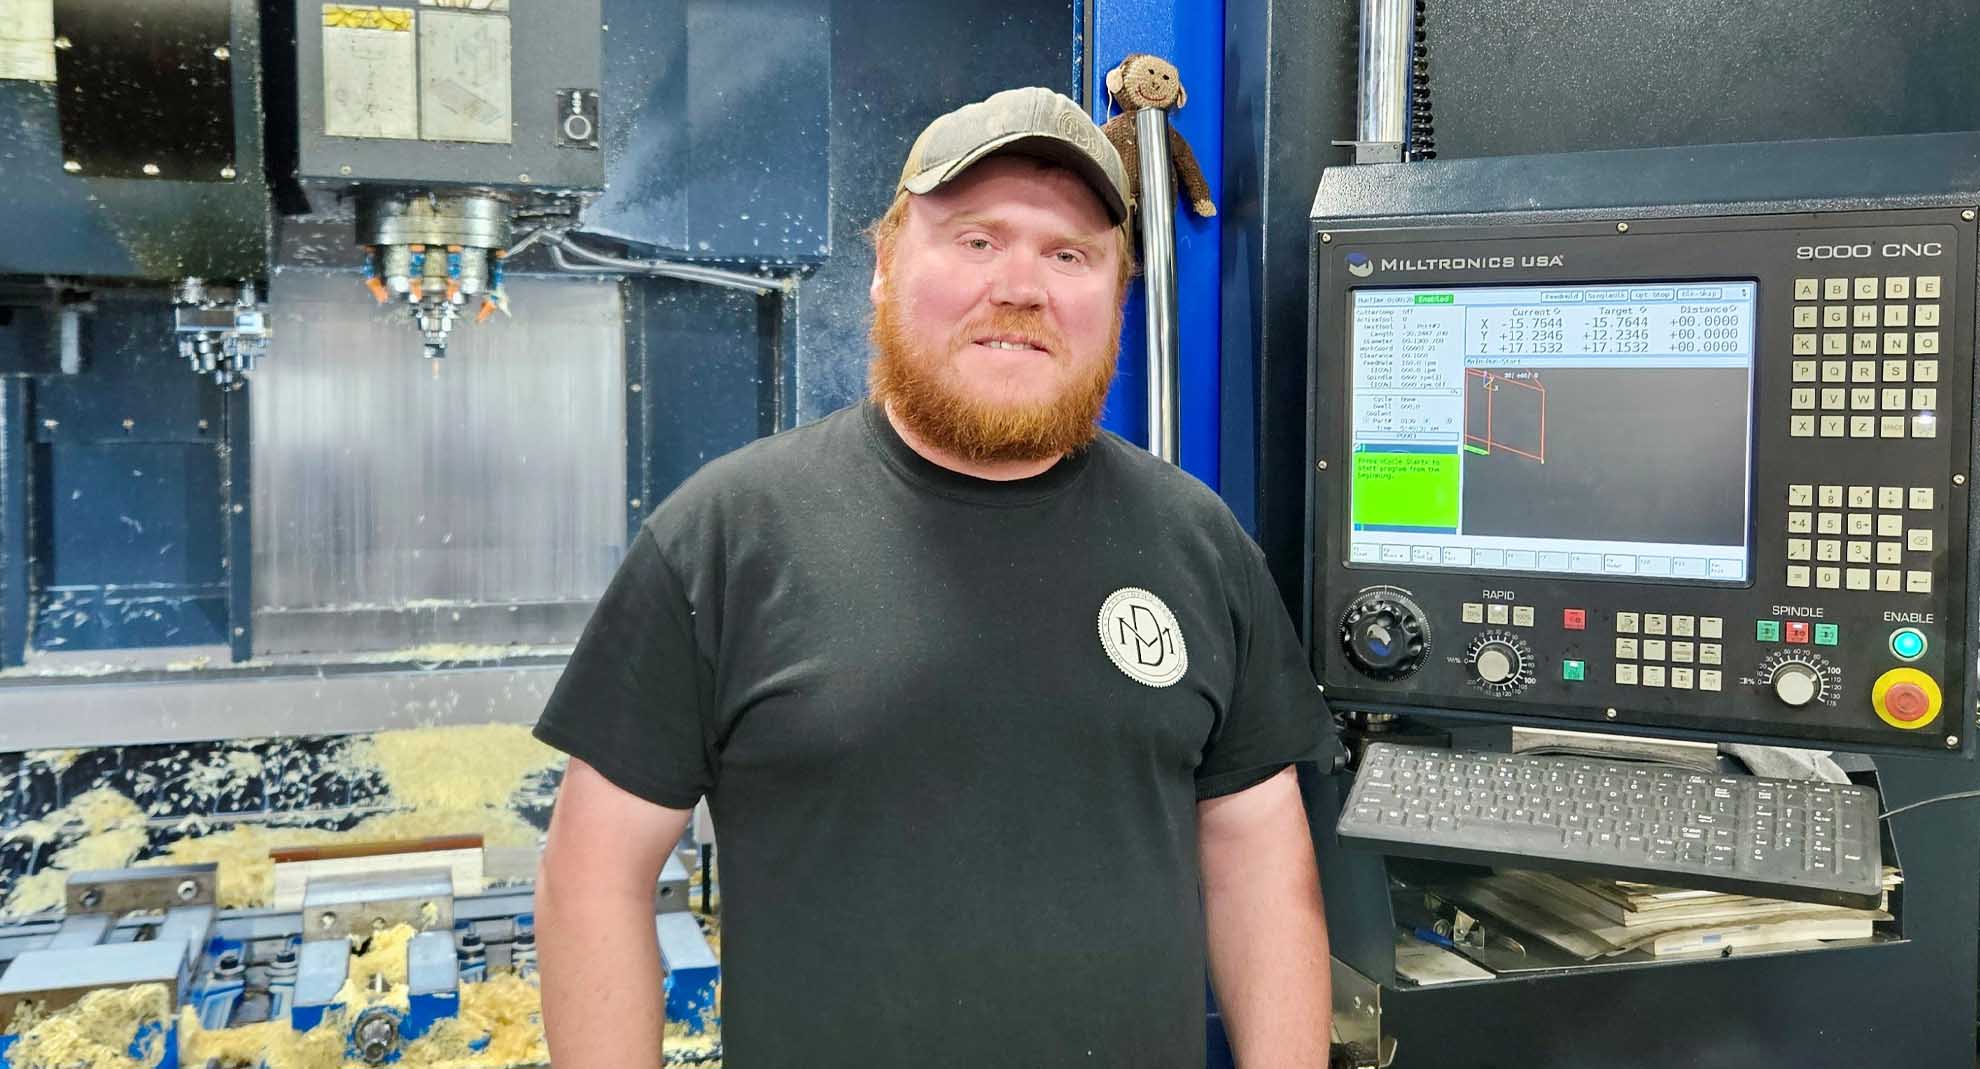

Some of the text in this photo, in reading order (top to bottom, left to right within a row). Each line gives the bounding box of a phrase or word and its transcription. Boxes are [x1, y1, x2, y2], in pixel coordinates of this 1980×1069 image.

[1796, 243, 1943, 259] 9000 CNC
[1380, 255, 1564, 271] MILLTRONICS USA
[1802, 283, 1934, 295] A B C D E
[1512, 308, 1551, 316] Current
[1599, 307, 1633, 316] Target
[1680, 305, 1728, 314] Distance
[1802, 311, 1932, 321] F G H I J
[1480, 318, 1489, 329] X
[1669, 315, 1739, 327] +00.0000
[1480, 328, 1738, 341] Y +12.2346 +12.2346 +00.0000
[1480, 341, 1738, 353] Z +17.1532 +17.1532 +00.0000
[1800, 339, 1933, 349] K L M N O
[1801, 367, 1932, 377] P Q R S T
[1799, 395, 1808, 404] U
[1829, 394, 1839, 404] V
[1858, 395, 1870, 403] W
[1799, 422, 1807, 431] X
[1829, 422, 1837, 431] Y
[1858, 422, 1867, 432] Z
[1800, 494, 1807, 503] 7
[1827, 495, 1834, 504] 8
[1856, 495, 1863, 505] 9
[1799, 518, 1862, 529] 4 5 6
[1800, 543, 1862, 554] 1 2 3
[1824, 573, 1830, 582] 0
[1482, 590, 1515, 600] RAPID
[1772, 605, 1824, 618] SPINDLE
[1883, 611, 1935, 625] ENABLE
[1827, 666, 1841, 674] 100
